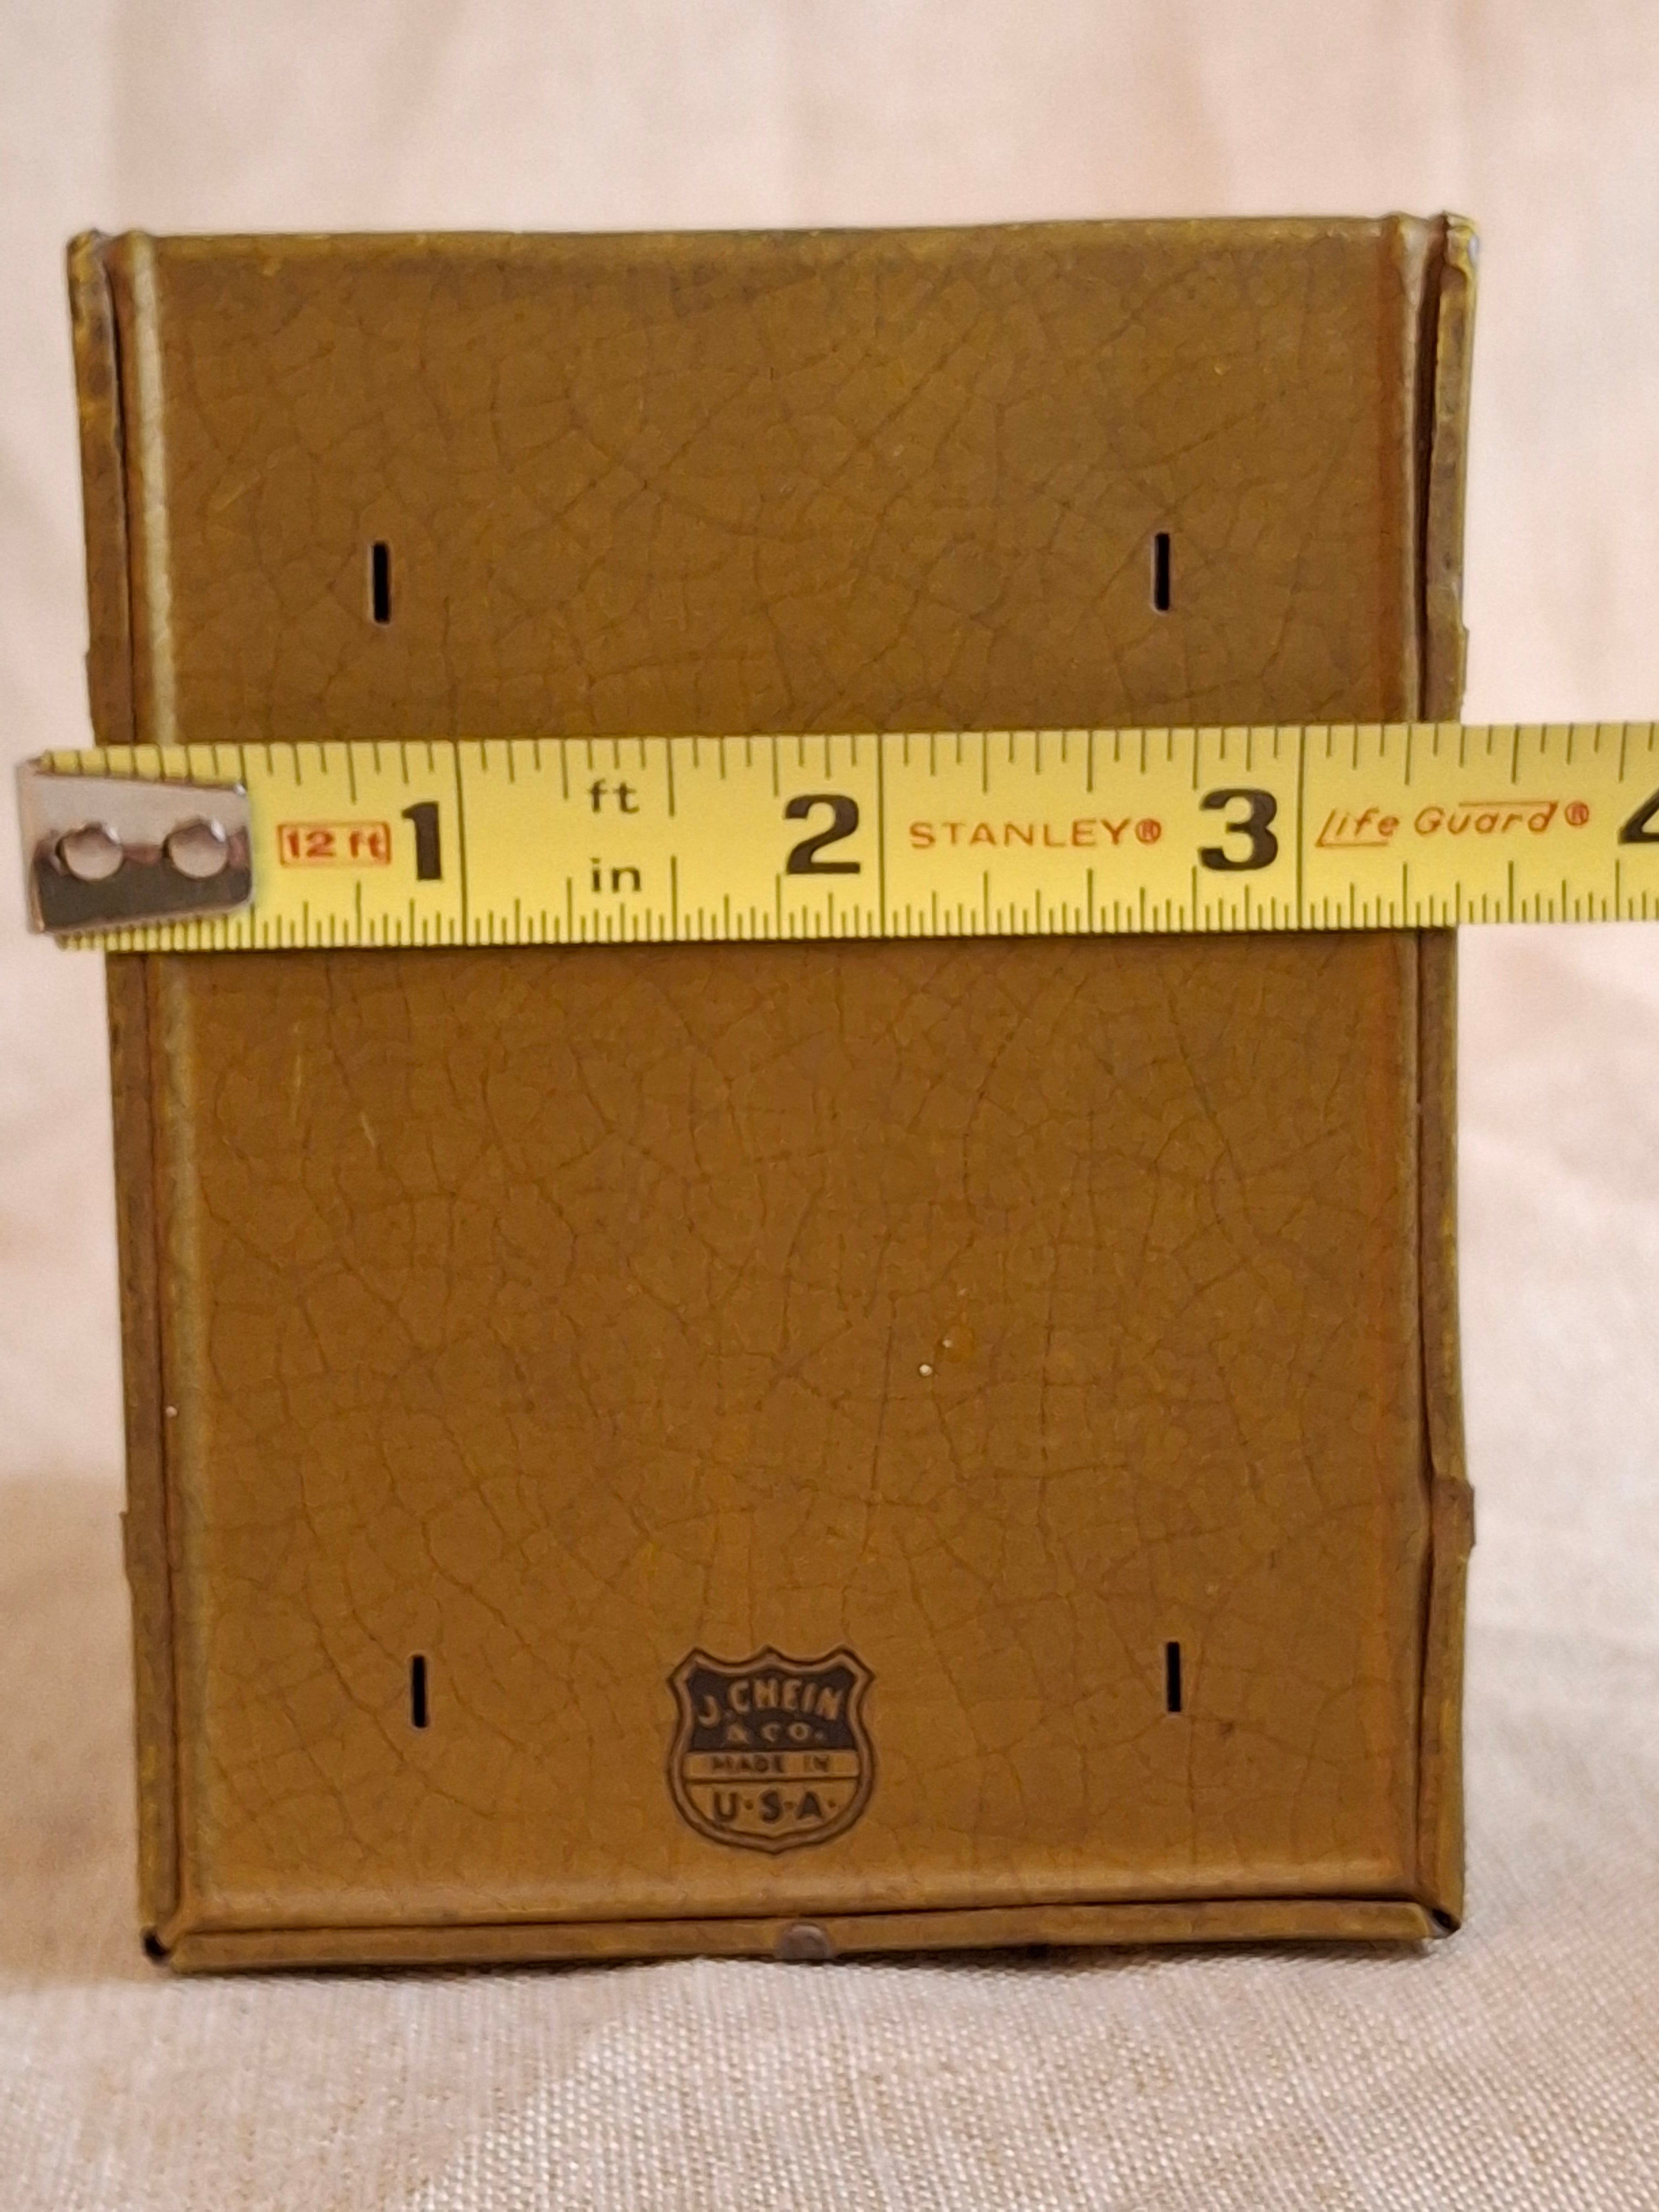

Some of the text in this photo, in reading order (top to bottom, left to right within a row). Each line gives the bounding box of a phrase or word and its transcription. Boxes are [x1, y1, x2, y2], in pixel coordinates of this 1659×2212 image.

[587, 778, 640, 814] ft
[286, 829, 387, 860] 12 ft
[402, 801, 443, 882] 1
[783, 793, 861, 875] 2
[1198, 788, 1278, 872] 3
[1314, 807, 1400, 848] Life
[591, 857, 642, 893] in
[711, 1754, 831, 1773] MADE IN
